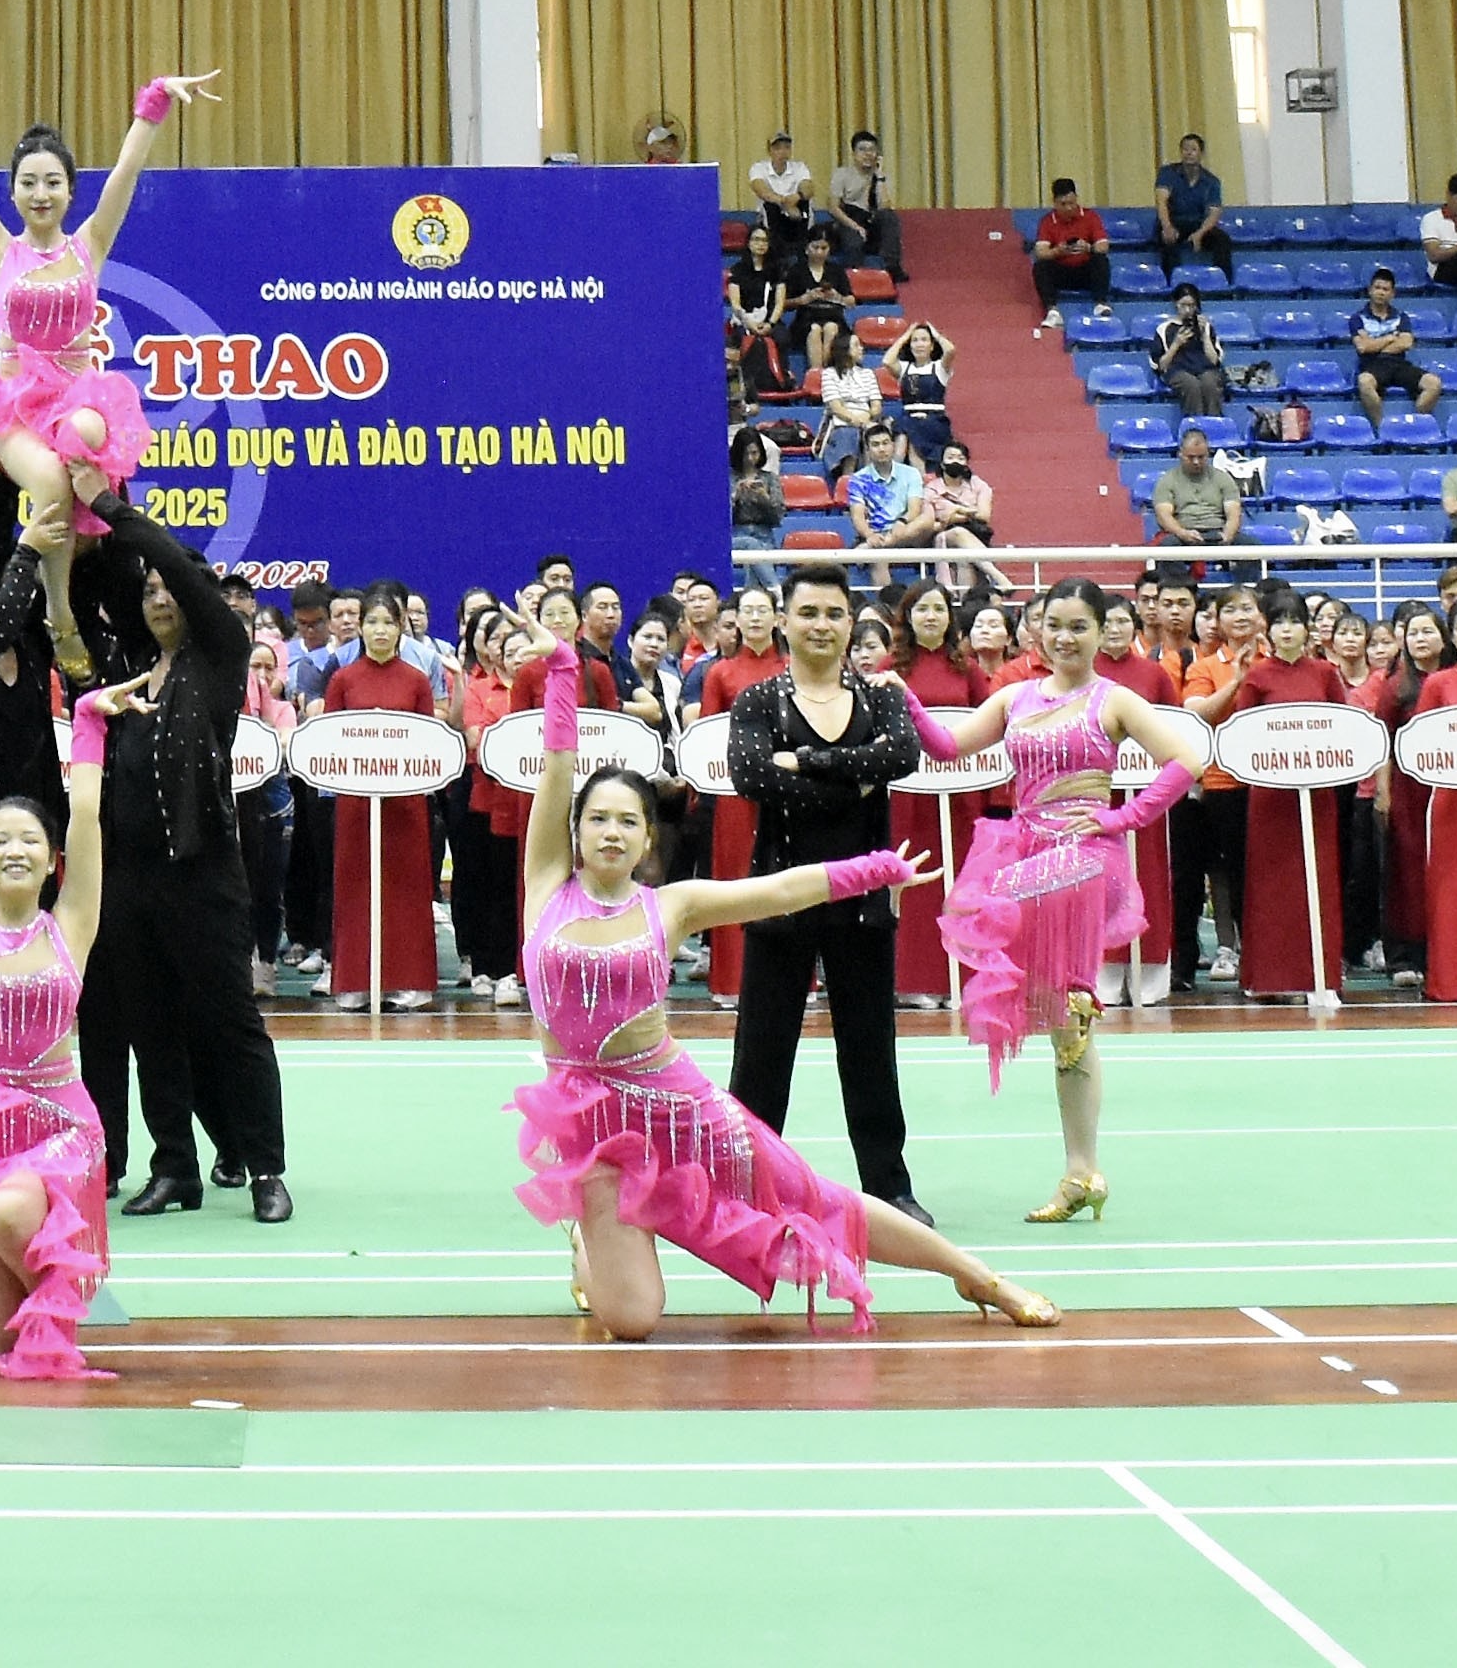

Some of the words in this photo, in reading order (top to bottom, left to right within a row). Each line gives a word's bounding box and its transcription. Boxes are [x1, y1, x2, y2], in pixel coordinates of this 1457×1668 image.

[261, 279, 316, 300] CÔNG
[320, 278, 372, 300] ĐOÀN
[378, 277, 442, 299] NGÀNH
[447, 277, 494, 299] GIÁO
[499, 281, 536, 303] DỤC
[541, 277, 566, 298] HÀ
[579, 276, 603, 303] NỘI
[133, 331, 389, 402] THAO
[140, 424, 216, 466] GIÁO
[228, 428, 294, 473] DỤC
[306, 424, 348, 465] VÀ
[359, 421, 426, 465] ĐÀO
[438, 427, 500, 472] TẠO
[512, 423, 556, 463] HÀ
[568, 419, 624, 471] NỘI
[310, 753, 347, 780] QUẬN
[354, 757, 398, 778] THANH
[404, 753, 441, 777] XUÂN
[976, 753, 1003, 771] MAI
[1252, 746, 1289, 774] QUẬN
[1295, 745, 1311, 769] HÀ
[1316, 748, 1354, 768] ĐÔNG
[1416, 748, 1454, 774] QUẬN
